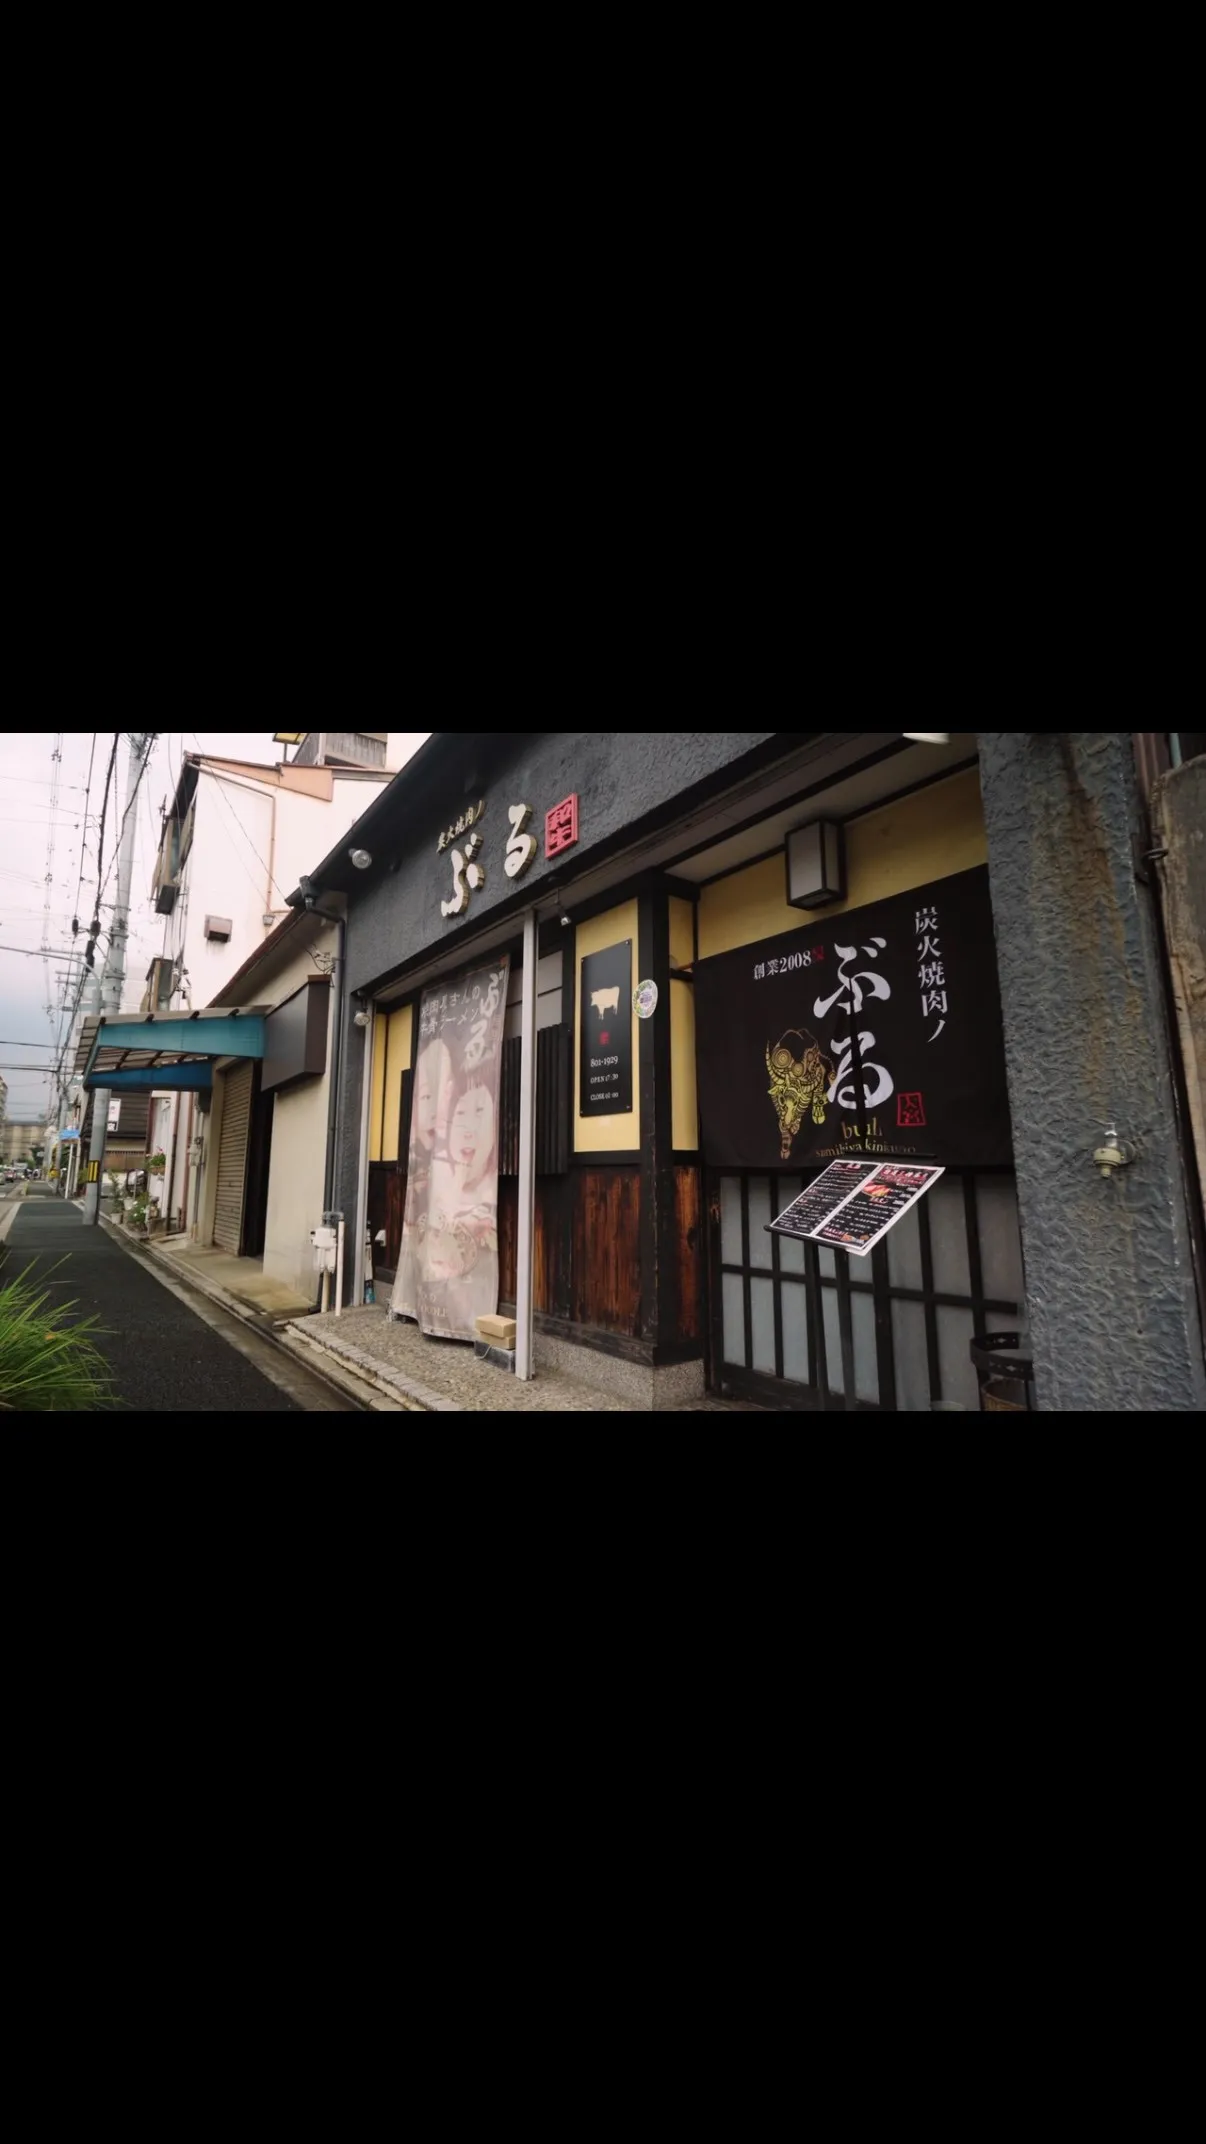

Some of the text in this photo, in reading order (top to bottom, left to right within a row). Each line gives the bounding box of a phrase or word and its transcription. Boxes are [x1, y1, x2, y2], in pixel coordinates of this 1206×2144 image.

[441, 803, 538, 918] ぶる
[753, 949, 813, 981] 創業2008
[812, 936, 895, 1110] ぶる
[914, 905, 949, 1043] 炭火焼肉ノ
